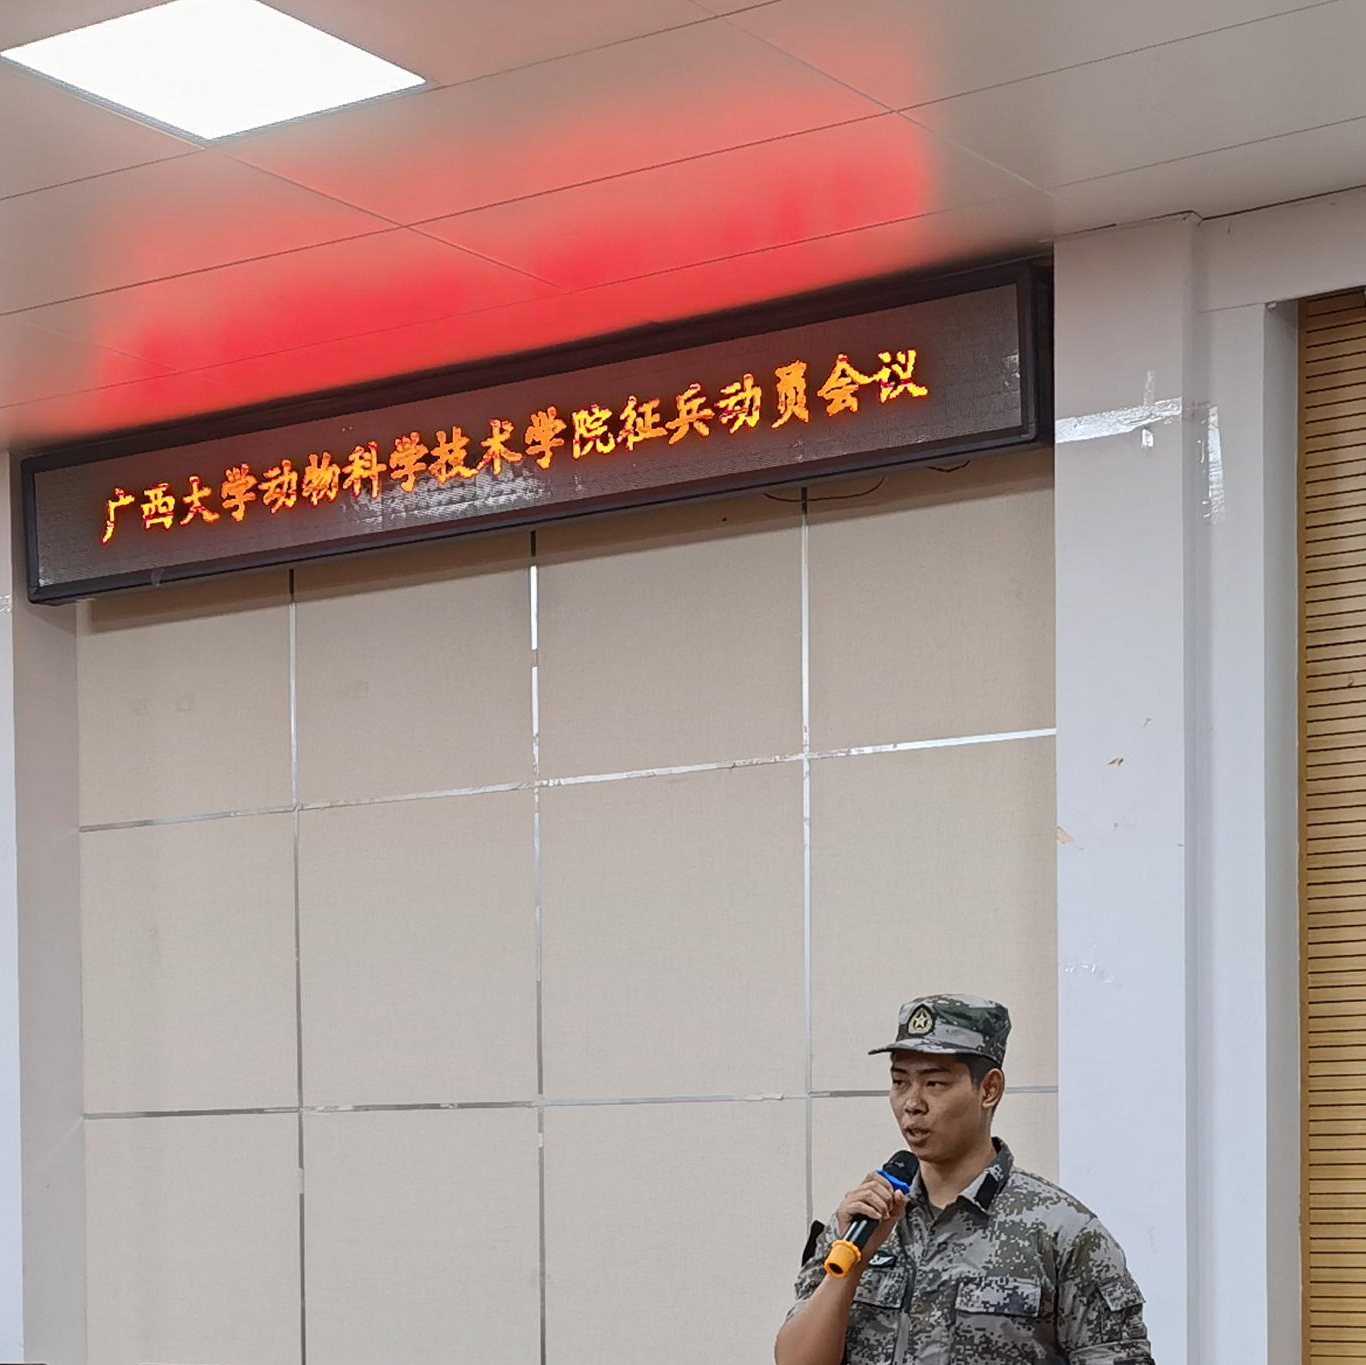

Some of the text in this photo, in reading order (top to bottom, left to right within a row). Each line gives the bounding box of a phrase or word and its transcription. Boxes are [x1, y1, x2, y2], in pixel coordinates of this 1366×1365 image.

[102, 349, 929, 544] 广西大学动物科学技术学院征兵动员会议
